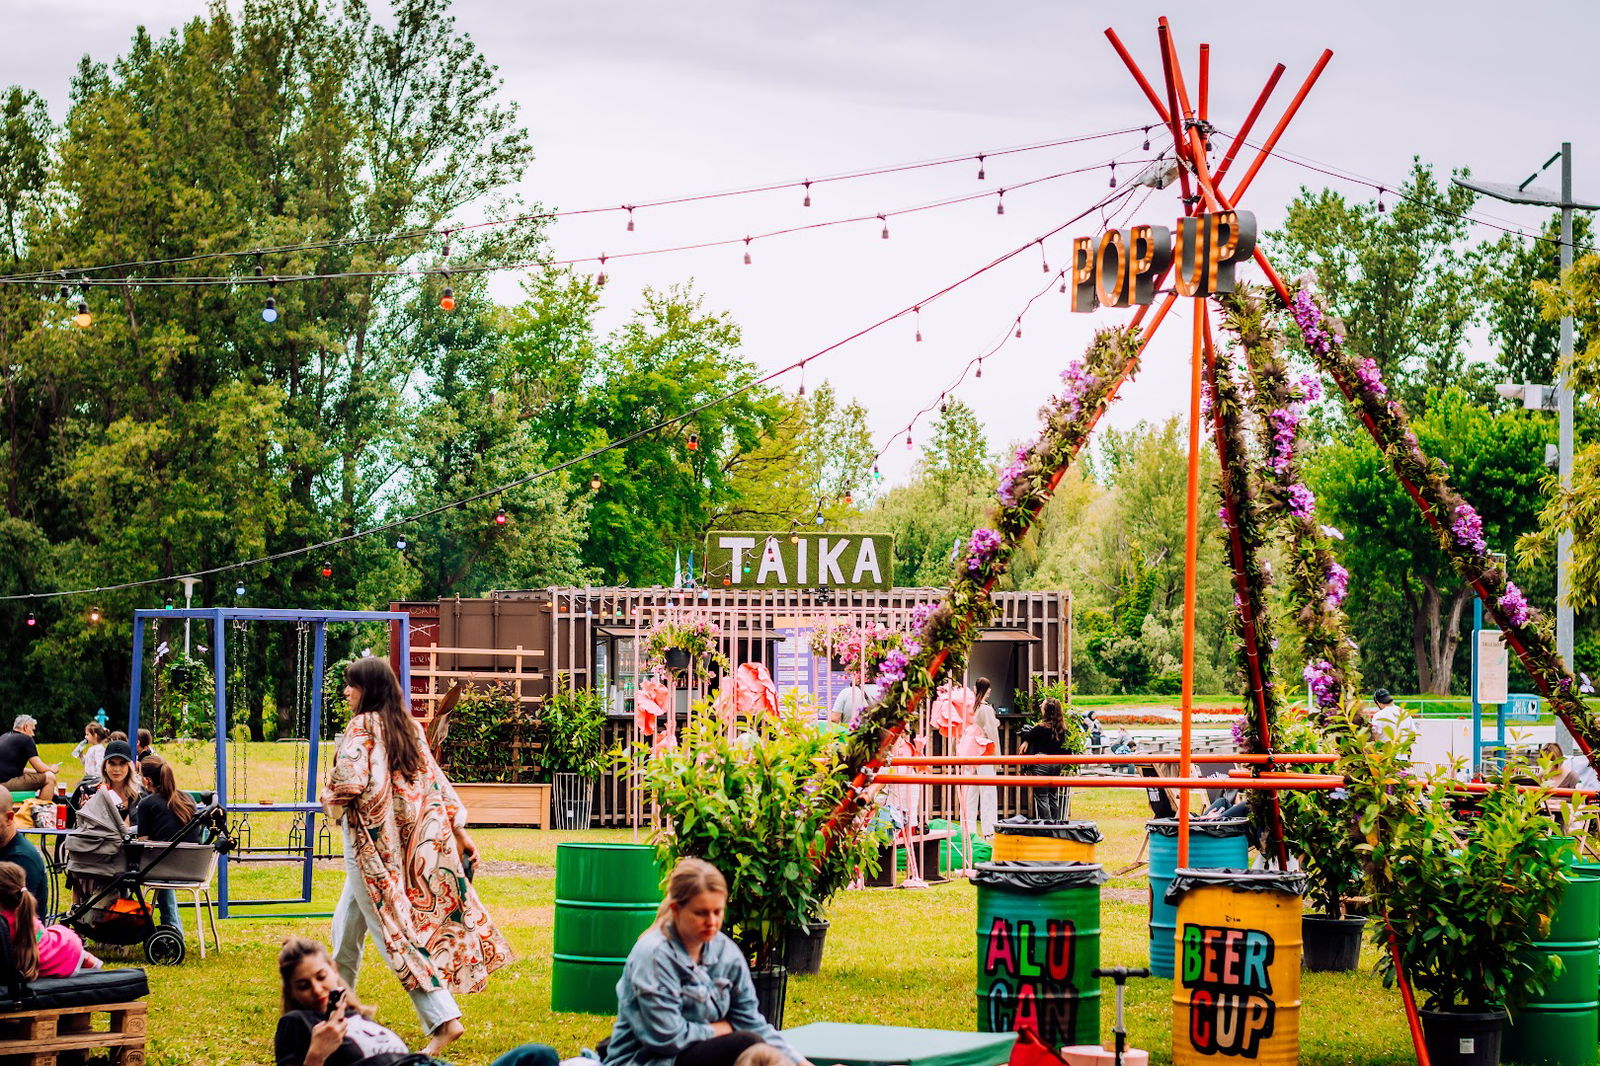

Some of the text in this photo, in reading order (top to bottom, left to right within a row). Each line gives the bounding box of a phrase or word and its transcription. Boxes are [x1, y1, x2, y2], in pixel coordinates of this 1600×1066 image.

[1071, 210, 1257, 312] POP UP
[719, 537, 882, 584] TAIKA
[984, 916, 1076, 981] ALU
[1182, 923, 1275, 994] BEER
[988, 979, 1079, 1045] CAN
[1190, 989, 1276, 1058] CUP
